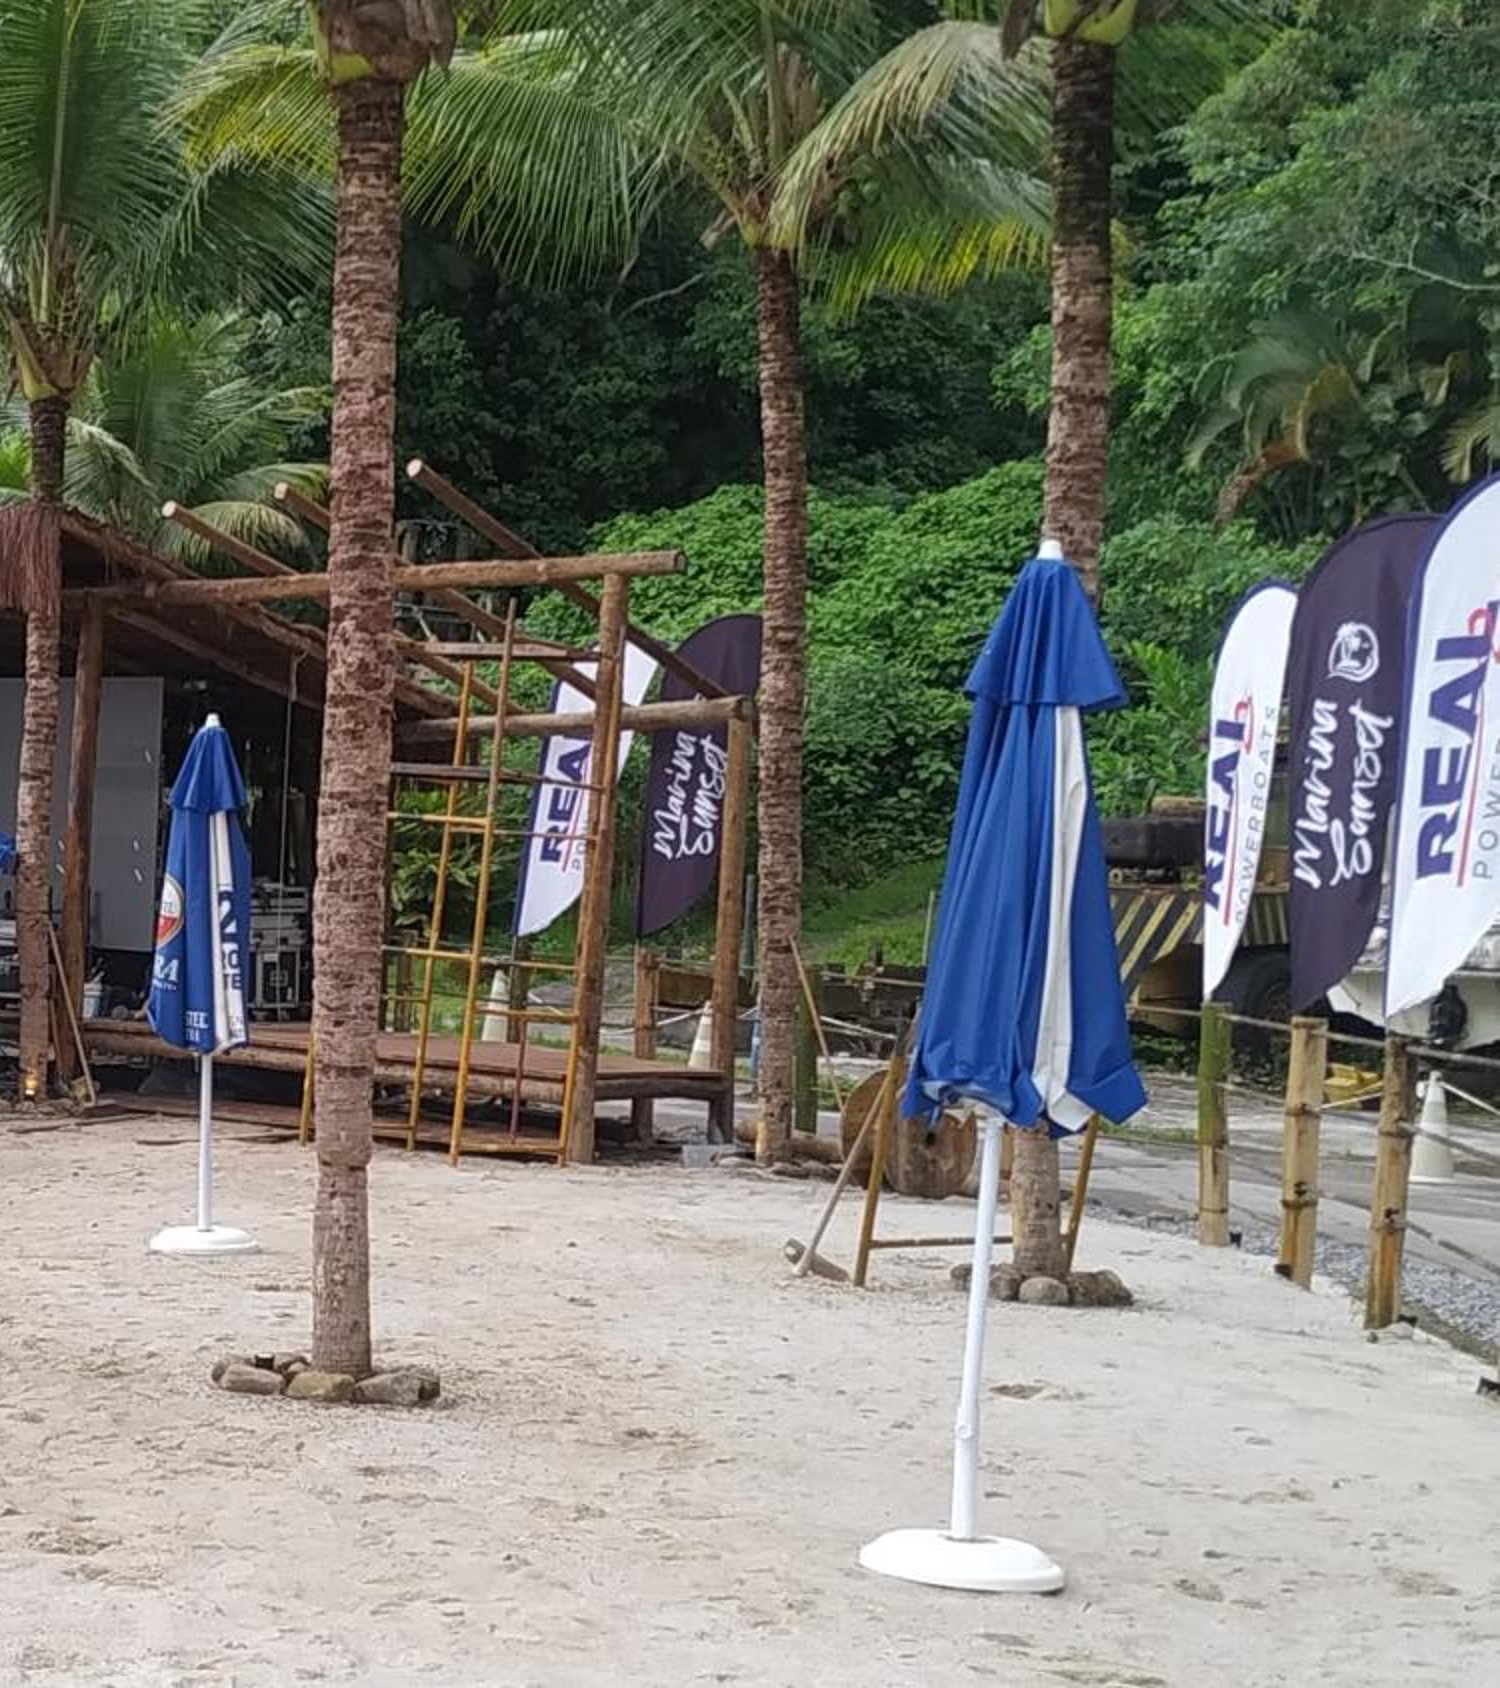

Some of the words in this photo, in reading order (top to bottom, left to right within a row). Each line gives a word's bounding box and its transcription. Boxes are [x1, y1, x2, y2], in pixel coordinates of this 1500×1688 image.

[540, 733, 592, 862] REA
[653, 731, 698, 860] Marina
[1294, 698, 1338, 889] Marina
[1329, 698, 1394, 887] Sunset
